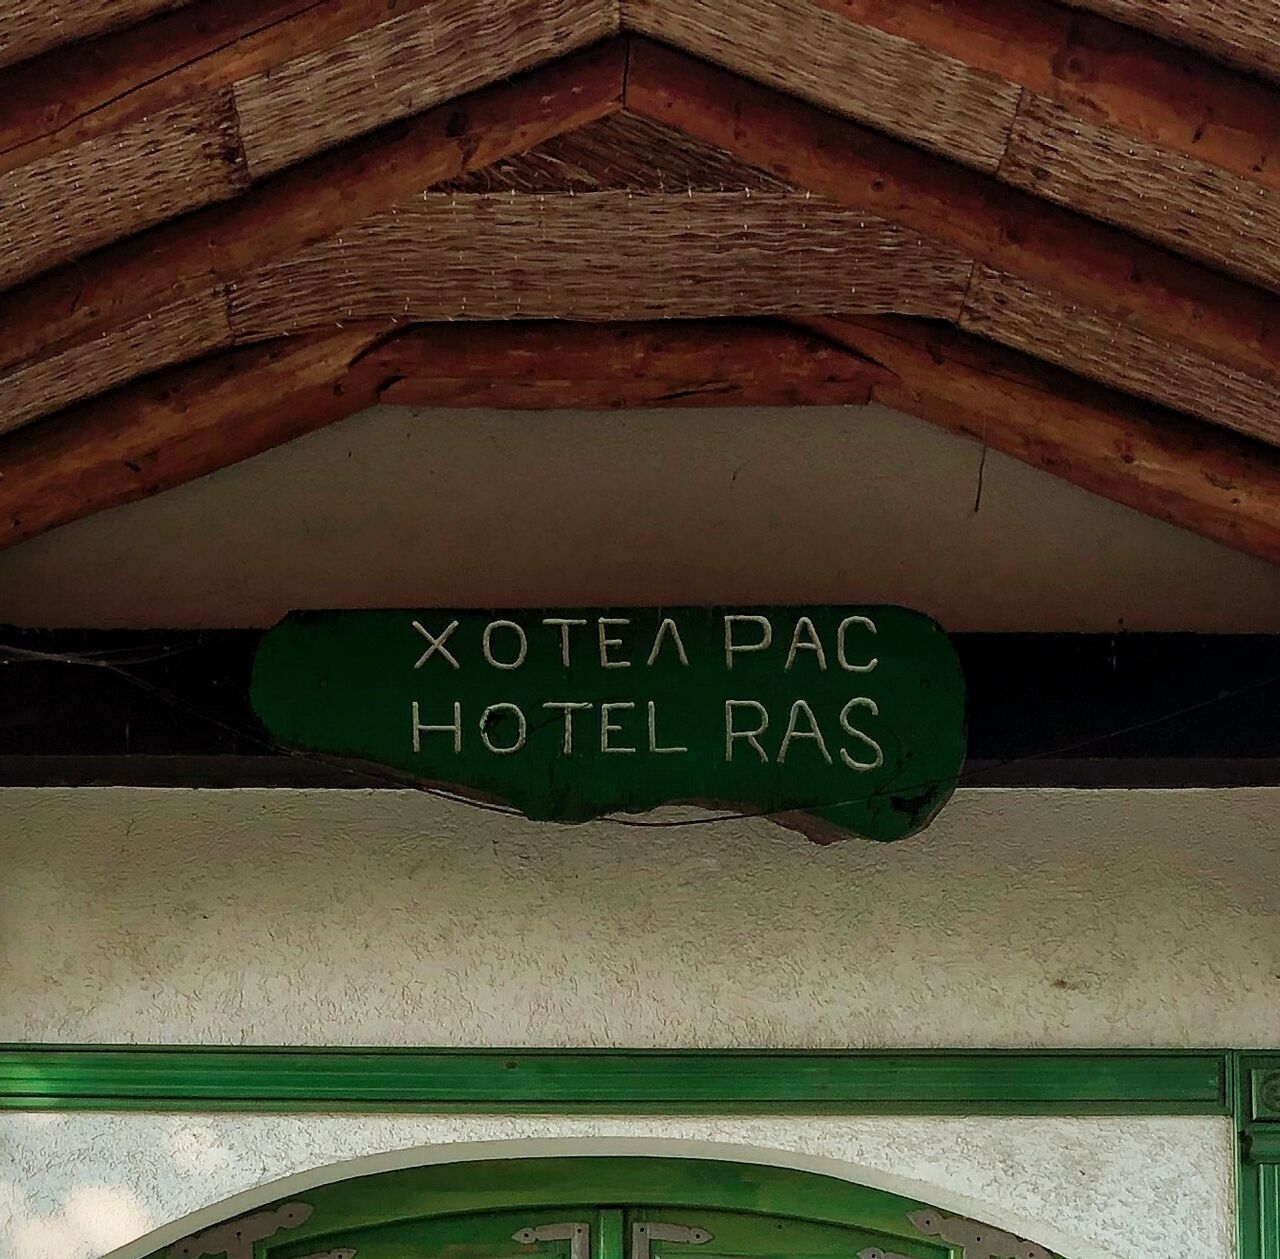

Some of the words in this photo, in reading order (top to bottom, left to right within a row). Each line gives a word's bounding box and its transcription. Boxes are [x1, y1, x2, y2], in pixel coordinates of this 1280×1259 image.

[723, 614, 880, 672] РАС
[412, 700, 688, 754] HOTEL
[725, 696, 884, 771] RAS
